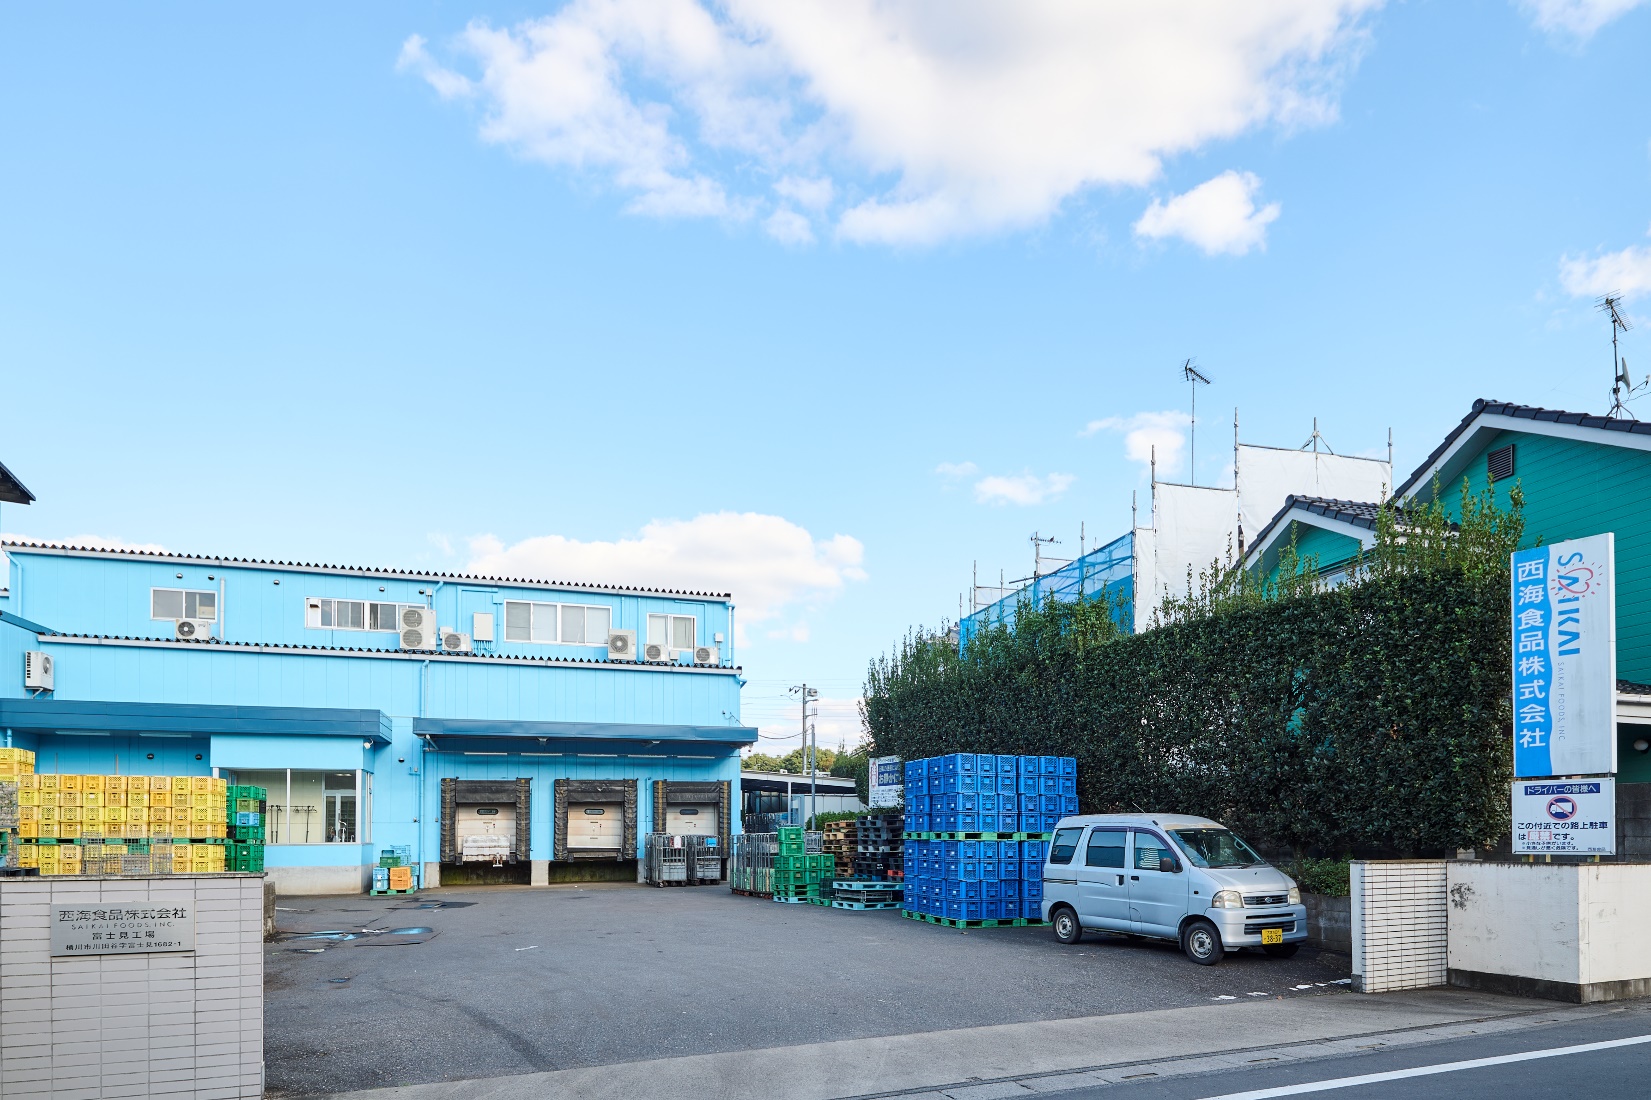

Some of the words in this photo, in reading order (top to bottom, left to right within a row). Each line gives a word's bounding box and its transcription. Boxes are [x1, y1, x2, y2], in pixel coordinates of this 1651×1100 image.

[1517, 558, 1546, 749] 西海食品株式会社
[1557, 661, 1565, 690] SAIKAI
[1526, 785, 1597, 795] ドライバーの皆様へ
[1517, 821, 1608, 830] この付近での路上駐車
[58, 907, 187, 922] 西海食品株式会社
[92, 930, 155, 940] 富士見工場
